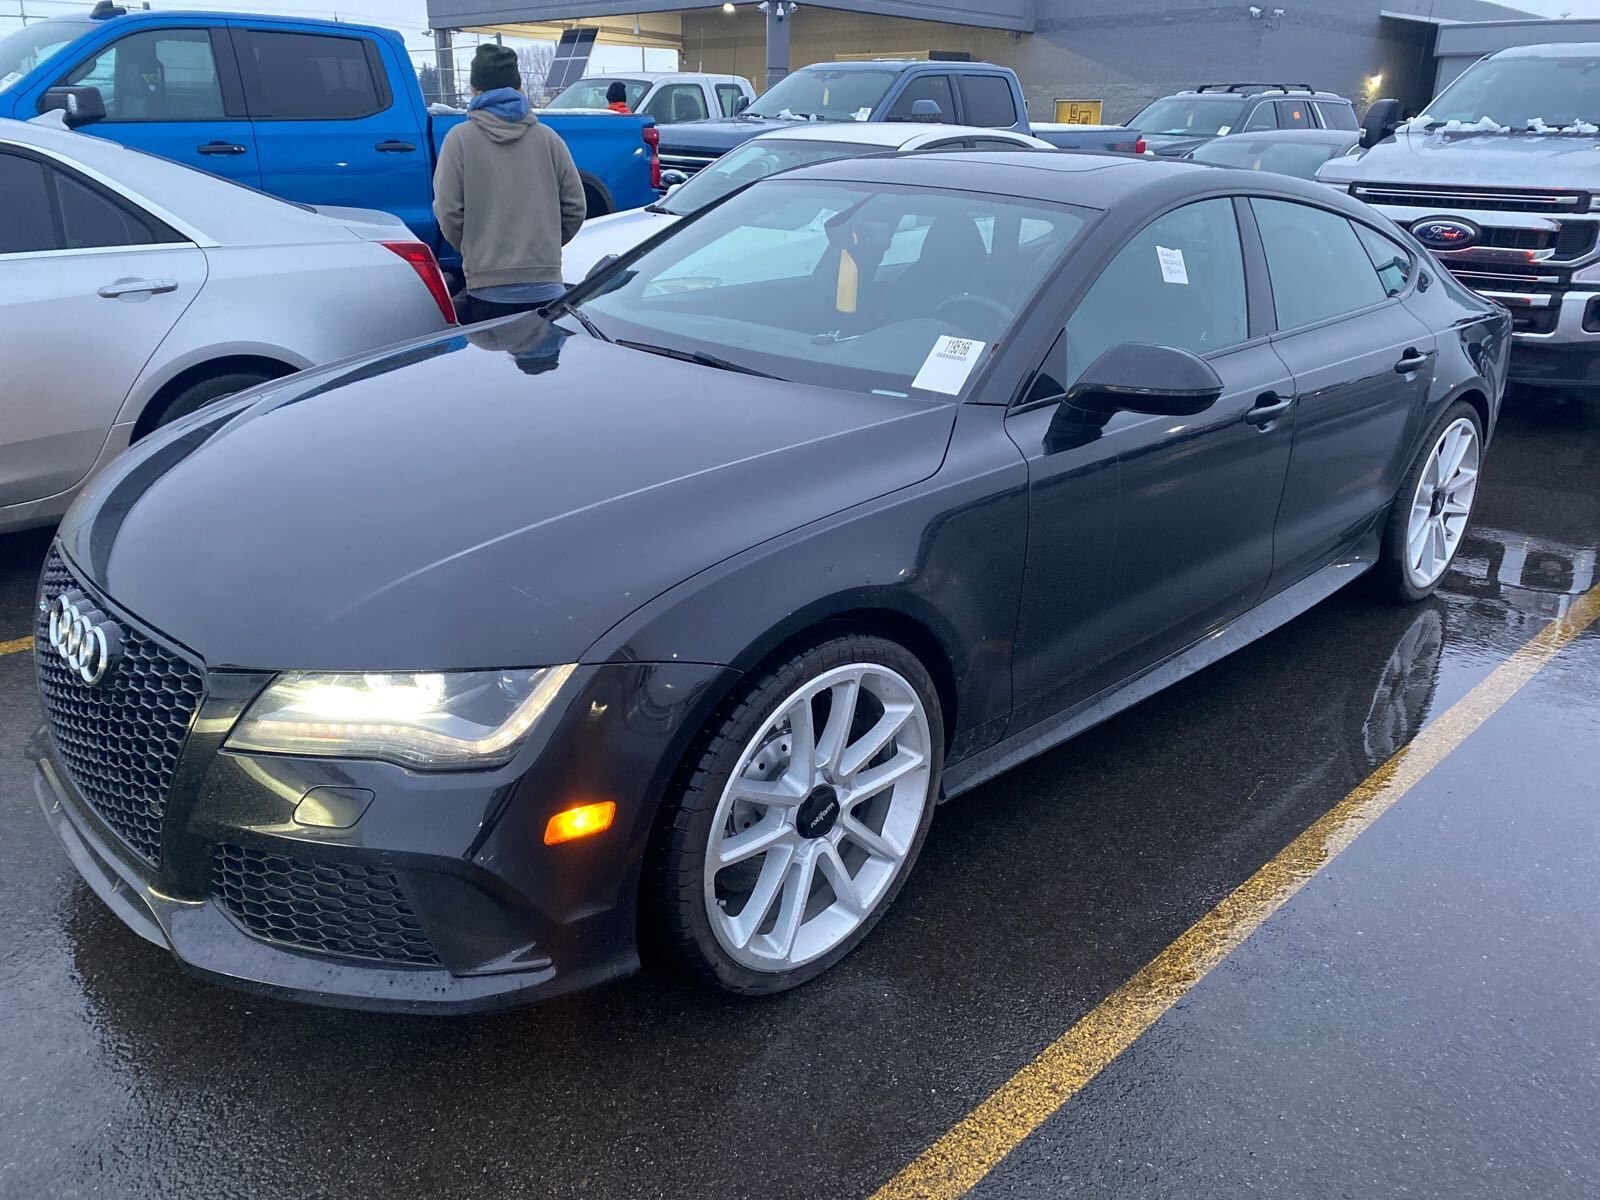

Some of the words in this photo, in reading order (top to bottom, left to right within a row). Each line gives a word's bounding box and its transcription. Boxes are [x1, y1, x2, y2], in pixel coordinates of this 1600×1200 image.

[1427, 225, 1463, 240] Ford
[944, 338, 973, 356] 1195166
[810, 802, 835, 829] rotiform
